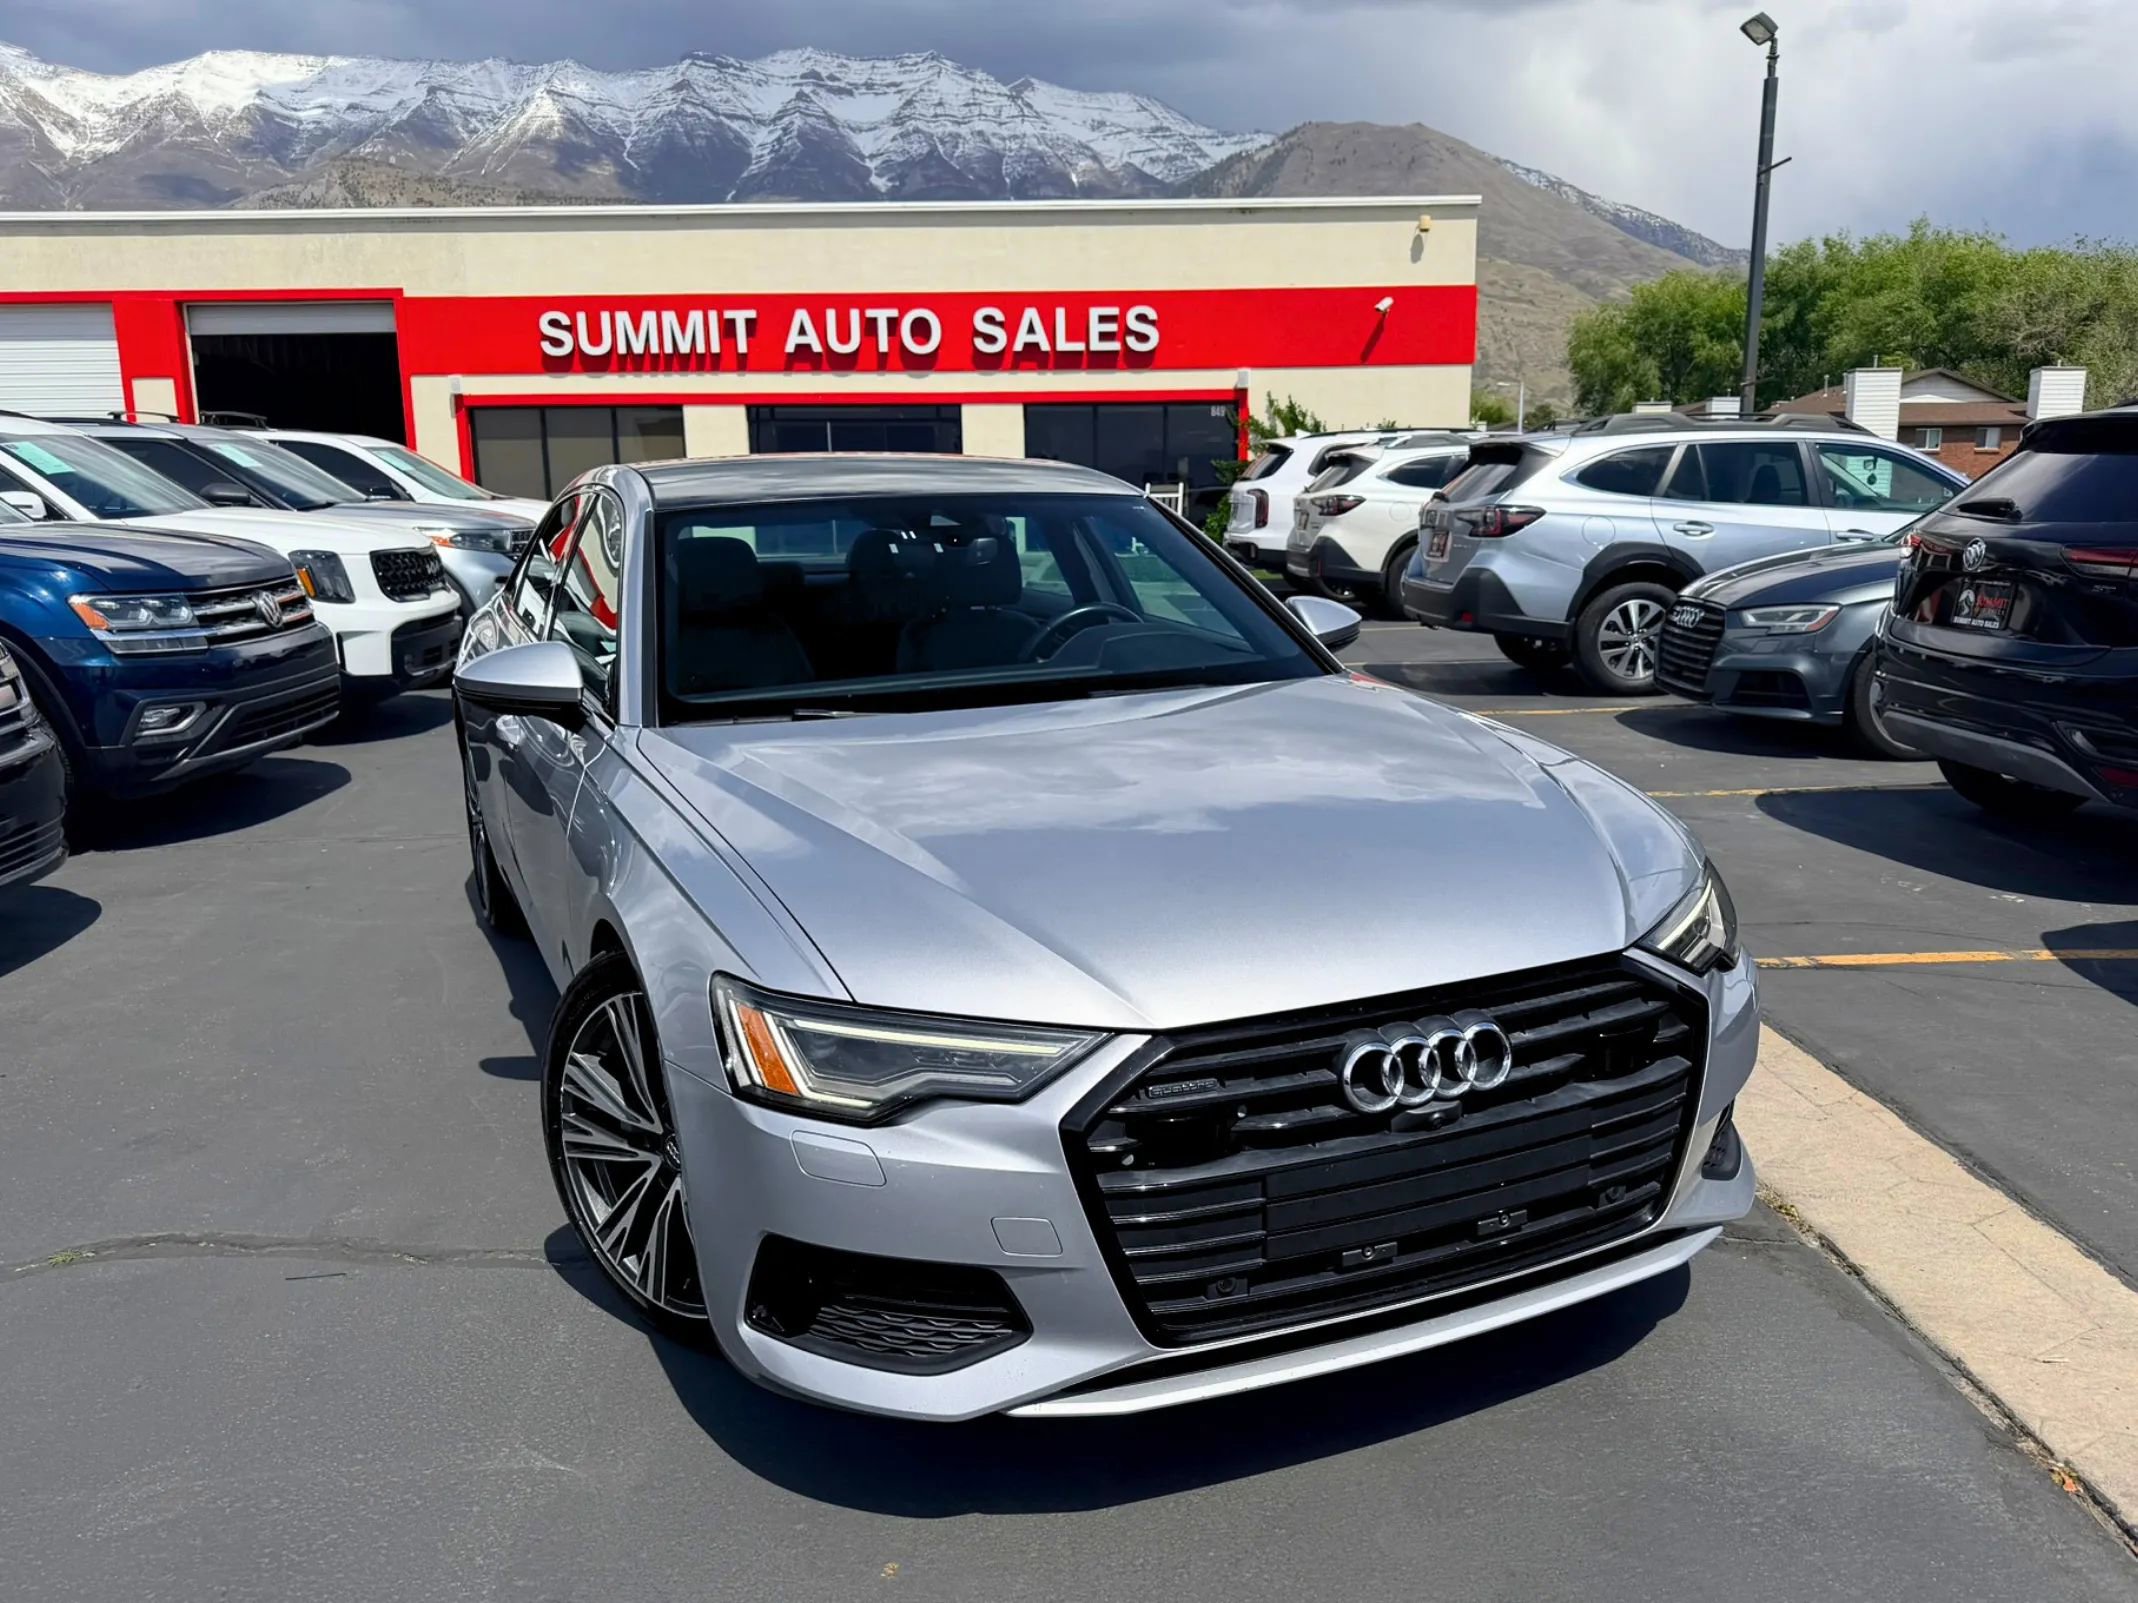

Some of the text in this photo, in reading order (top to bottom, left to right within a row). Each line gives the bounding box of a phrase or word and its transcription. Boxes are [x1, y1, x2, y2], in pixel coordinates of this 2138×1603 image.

[539, 305, 1160, 357] SUMMIT AUTO SALES
